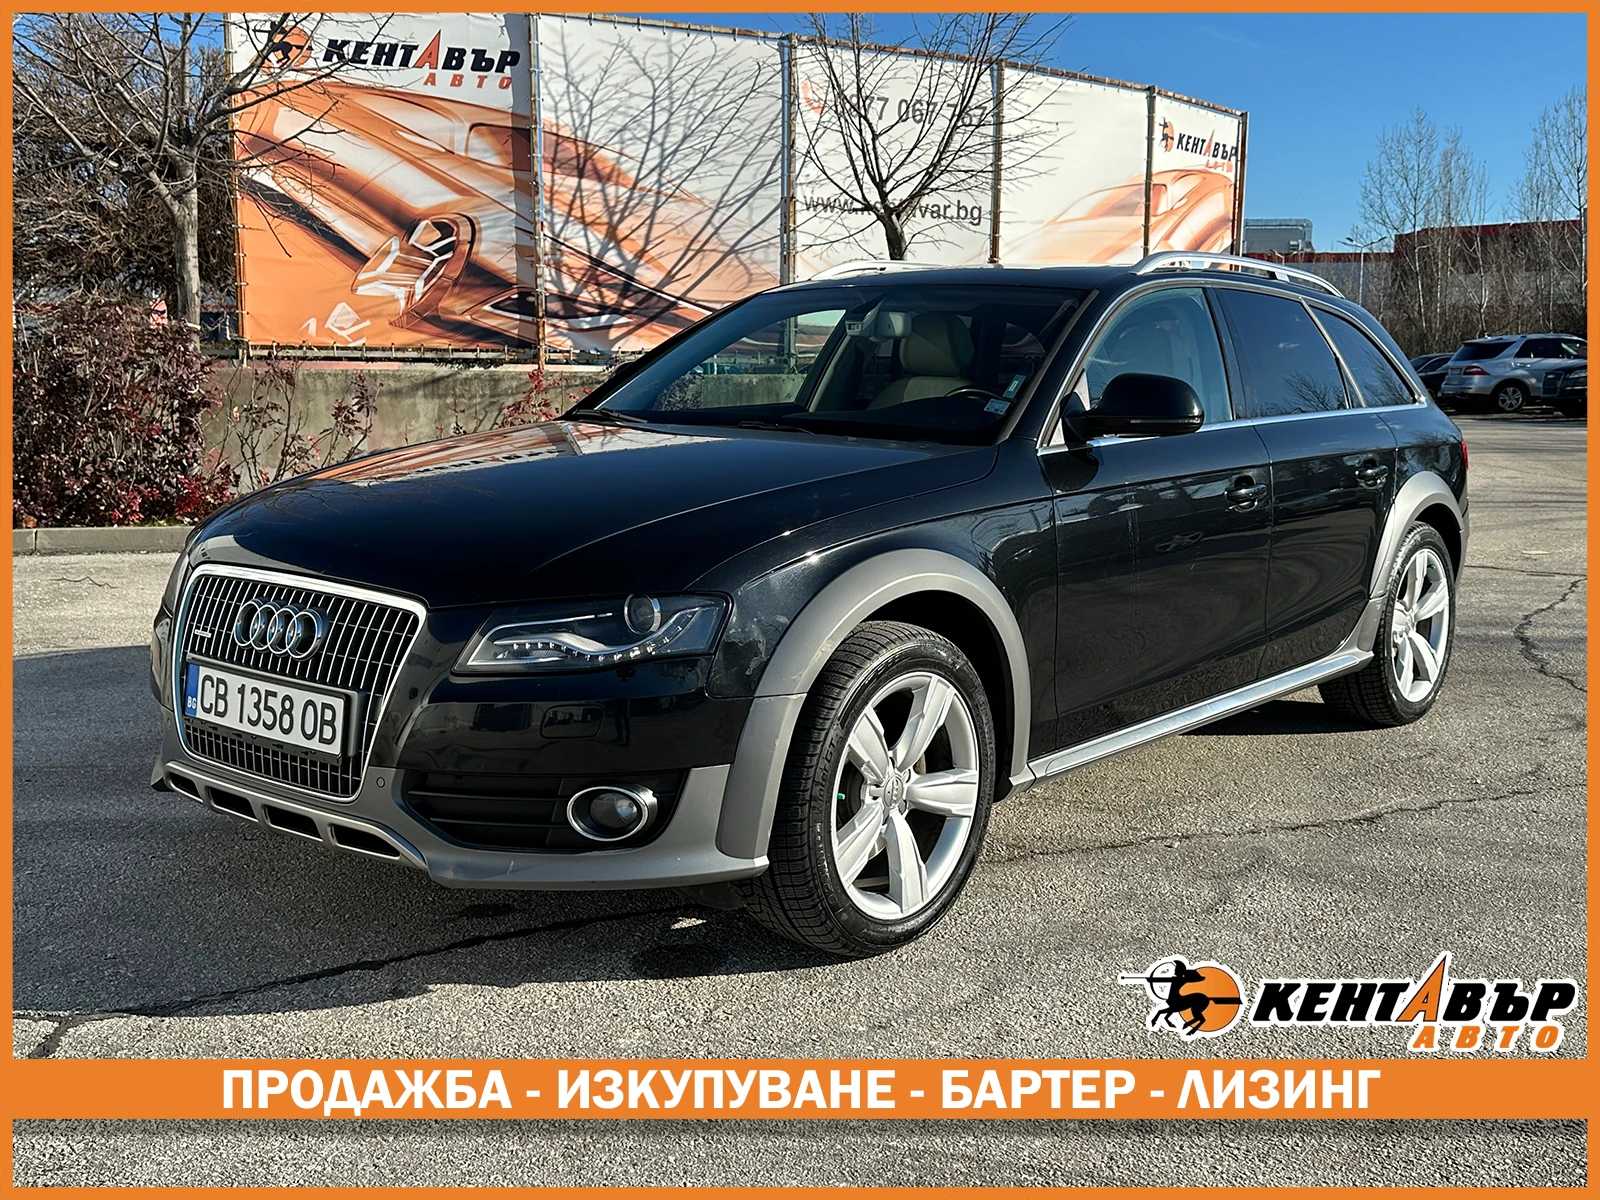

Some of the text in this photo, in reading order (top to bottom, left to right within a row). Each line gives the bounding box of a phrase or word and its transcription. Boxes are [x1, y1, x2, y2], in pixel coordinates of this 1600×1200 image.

[322, 29, 521, 74] КЕНТАВЪР
[423, 72, 513, 90] АВТО
[1176, 128, 1237, 162] КЕНТАВЪР
[187, 698, 197, 710] BG
[200, 673, 229, 719] CB
[237, 683, 294, 736] 1358
